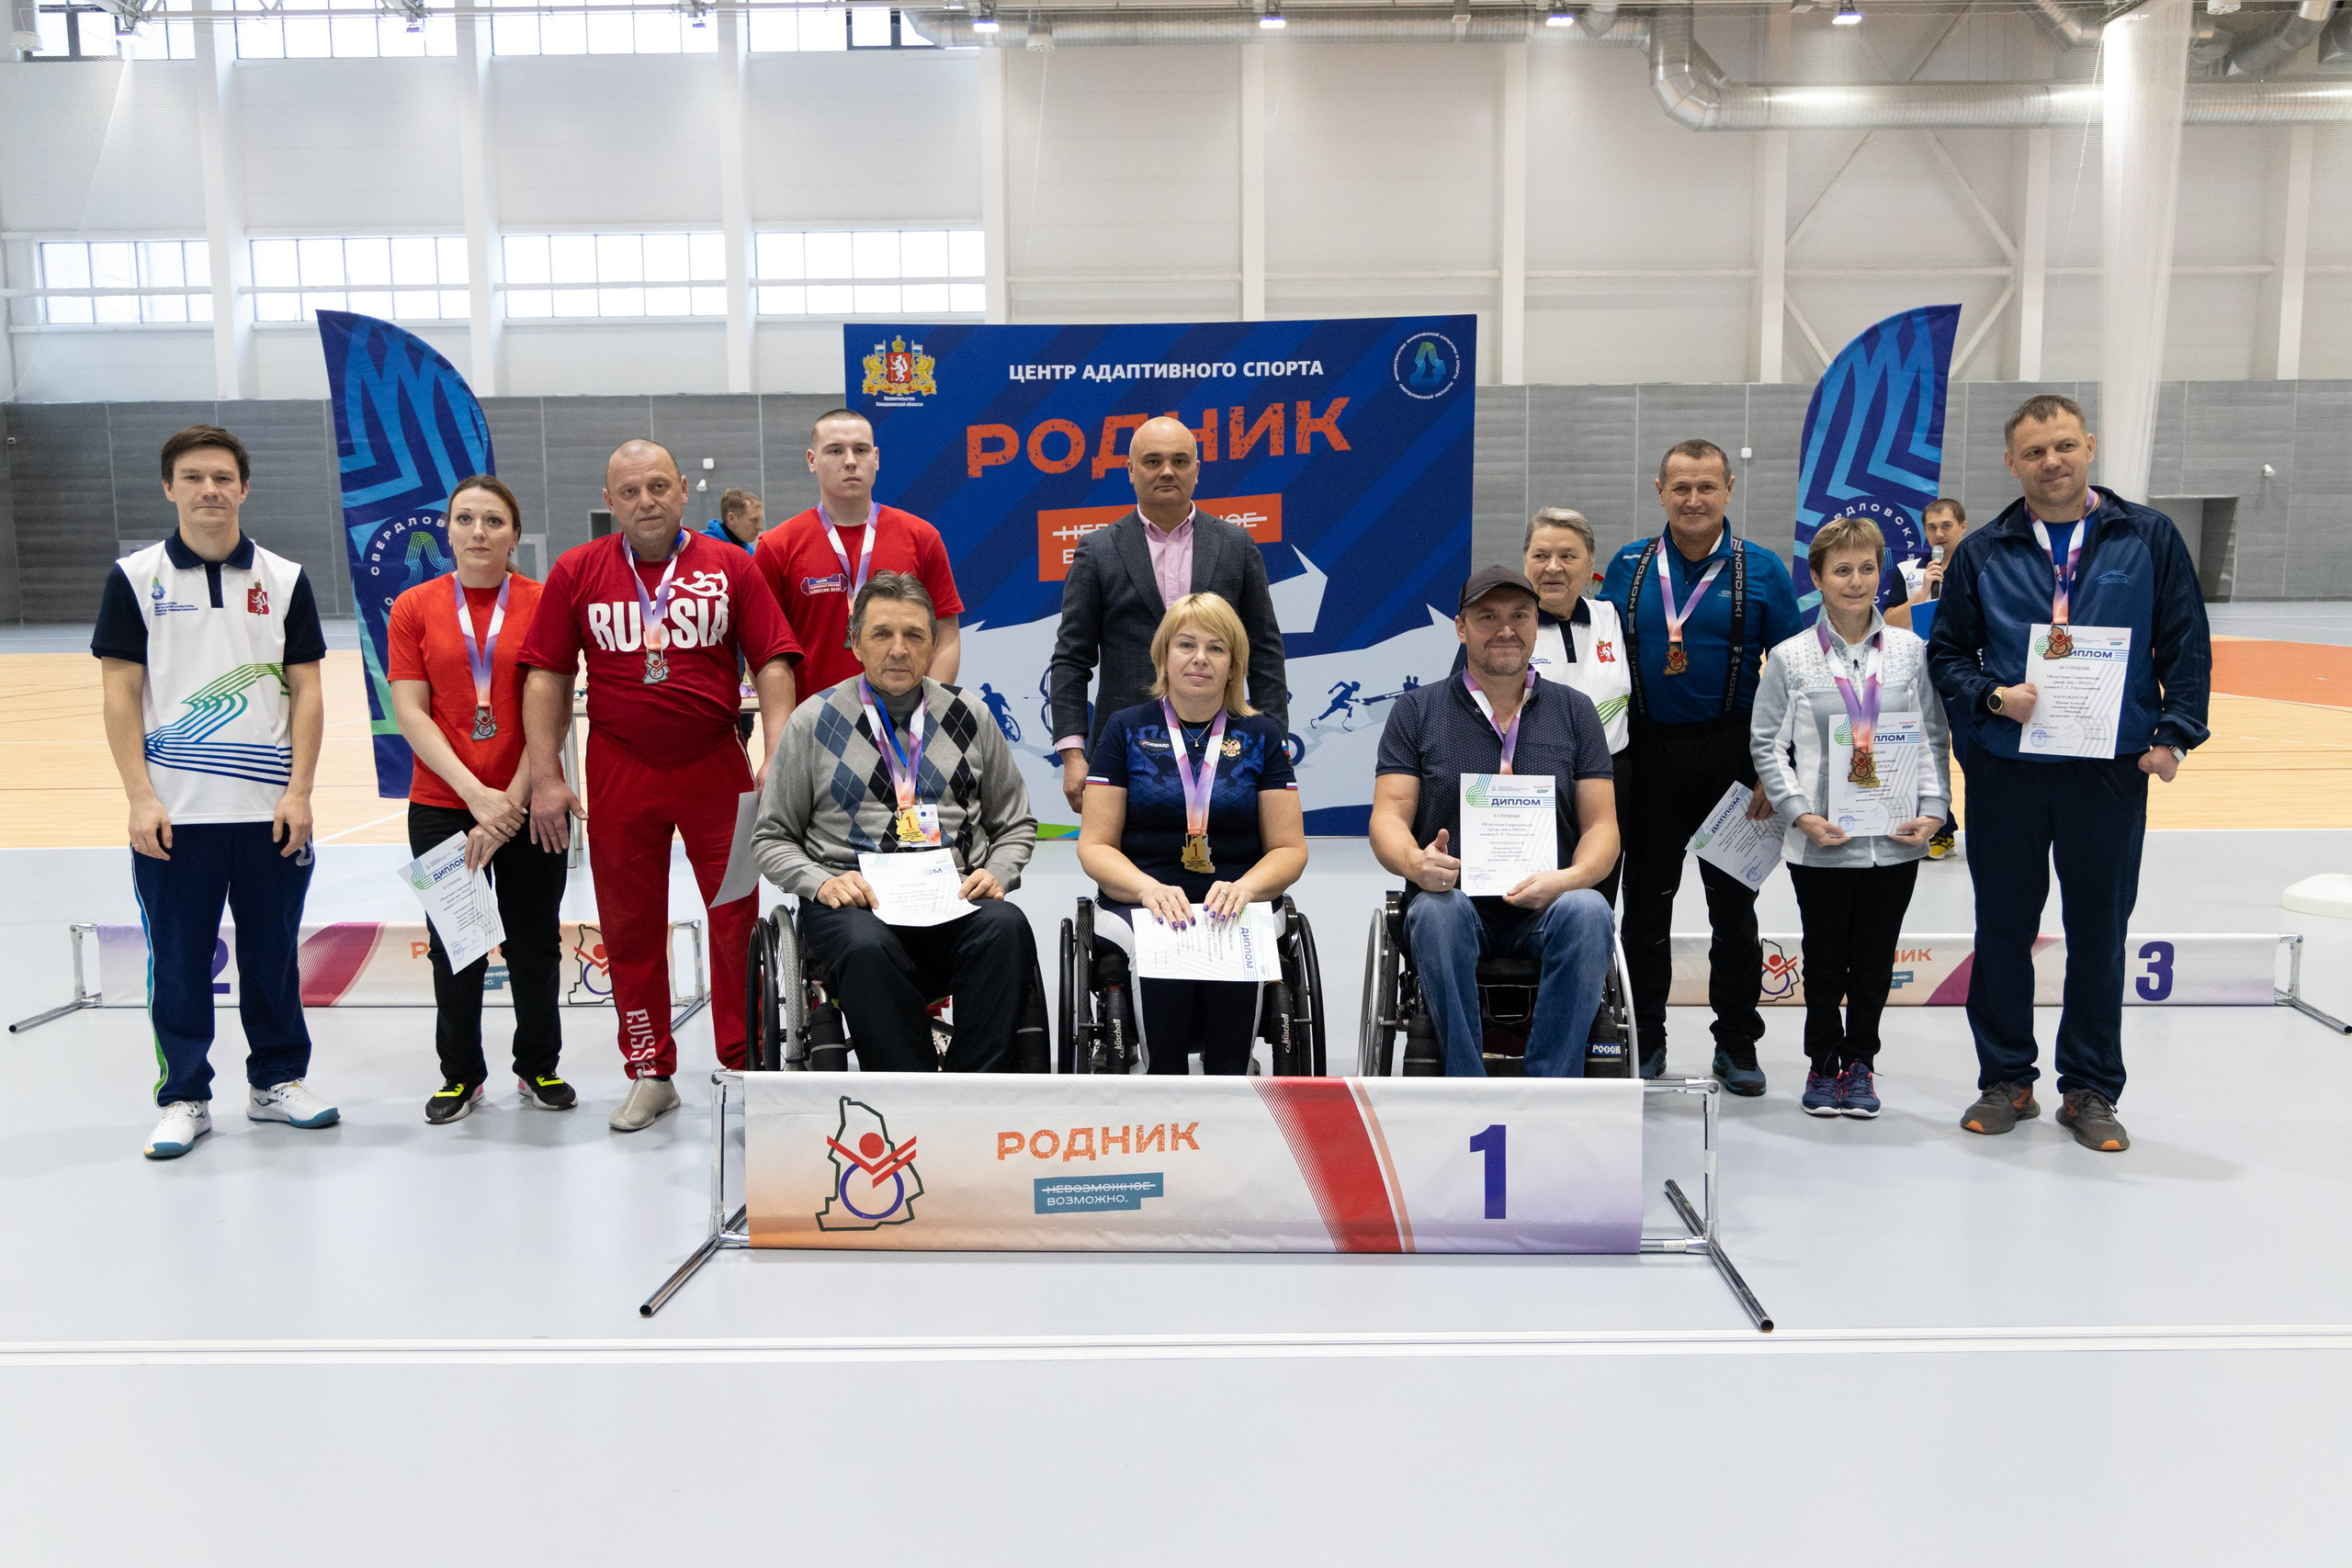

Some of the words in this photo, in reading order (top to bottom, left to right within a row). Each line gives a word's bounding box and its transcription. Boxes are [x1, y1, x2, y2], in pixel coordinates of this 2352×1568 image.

[1009, 365, 1077, 383] ЦЕНТР
[1082, 362, 1237, 383] АДАПТИВНОГО
[1242, 360, 1324, 378] СПОРТА
[967, 397, 1351, 479] РОДНИК
[370, 515, 446, 576] СВЕРДЛОВ
[1833, 502, 1916, 561] РДЛОВСКАЯ
[1629, 544, 1657, 610] NORDSKI
[1735, 553, 1743, 617] NORDSKI
[2070, 650, 2112, 659] ИПЛОМ
[1491, 798, 1541, 807] ДИПЛОМ
[1711, 796, 1741, 834] ДИПЛОМ
[906, 817, 912, 829] 1
[433, 855, 466, 882] ДИПЛОМ
[1193, 843, 1198, 856] 1
[1240, 927, 1253, 969] ДИПЛОМ
[2135, 941, 2175, 1001] 3
[1591, 1043, 1622, 1055] РОССИ
[997, 1122, 1201, 1163] РОДНИК
[1046, 1181, 1151, 1194] НЕВОЗМОЖНОЕ
[1469, 1124, 1507, 1220] 1
[1046, 1194, 1128, 1206] ВОЗМОЖНО.
